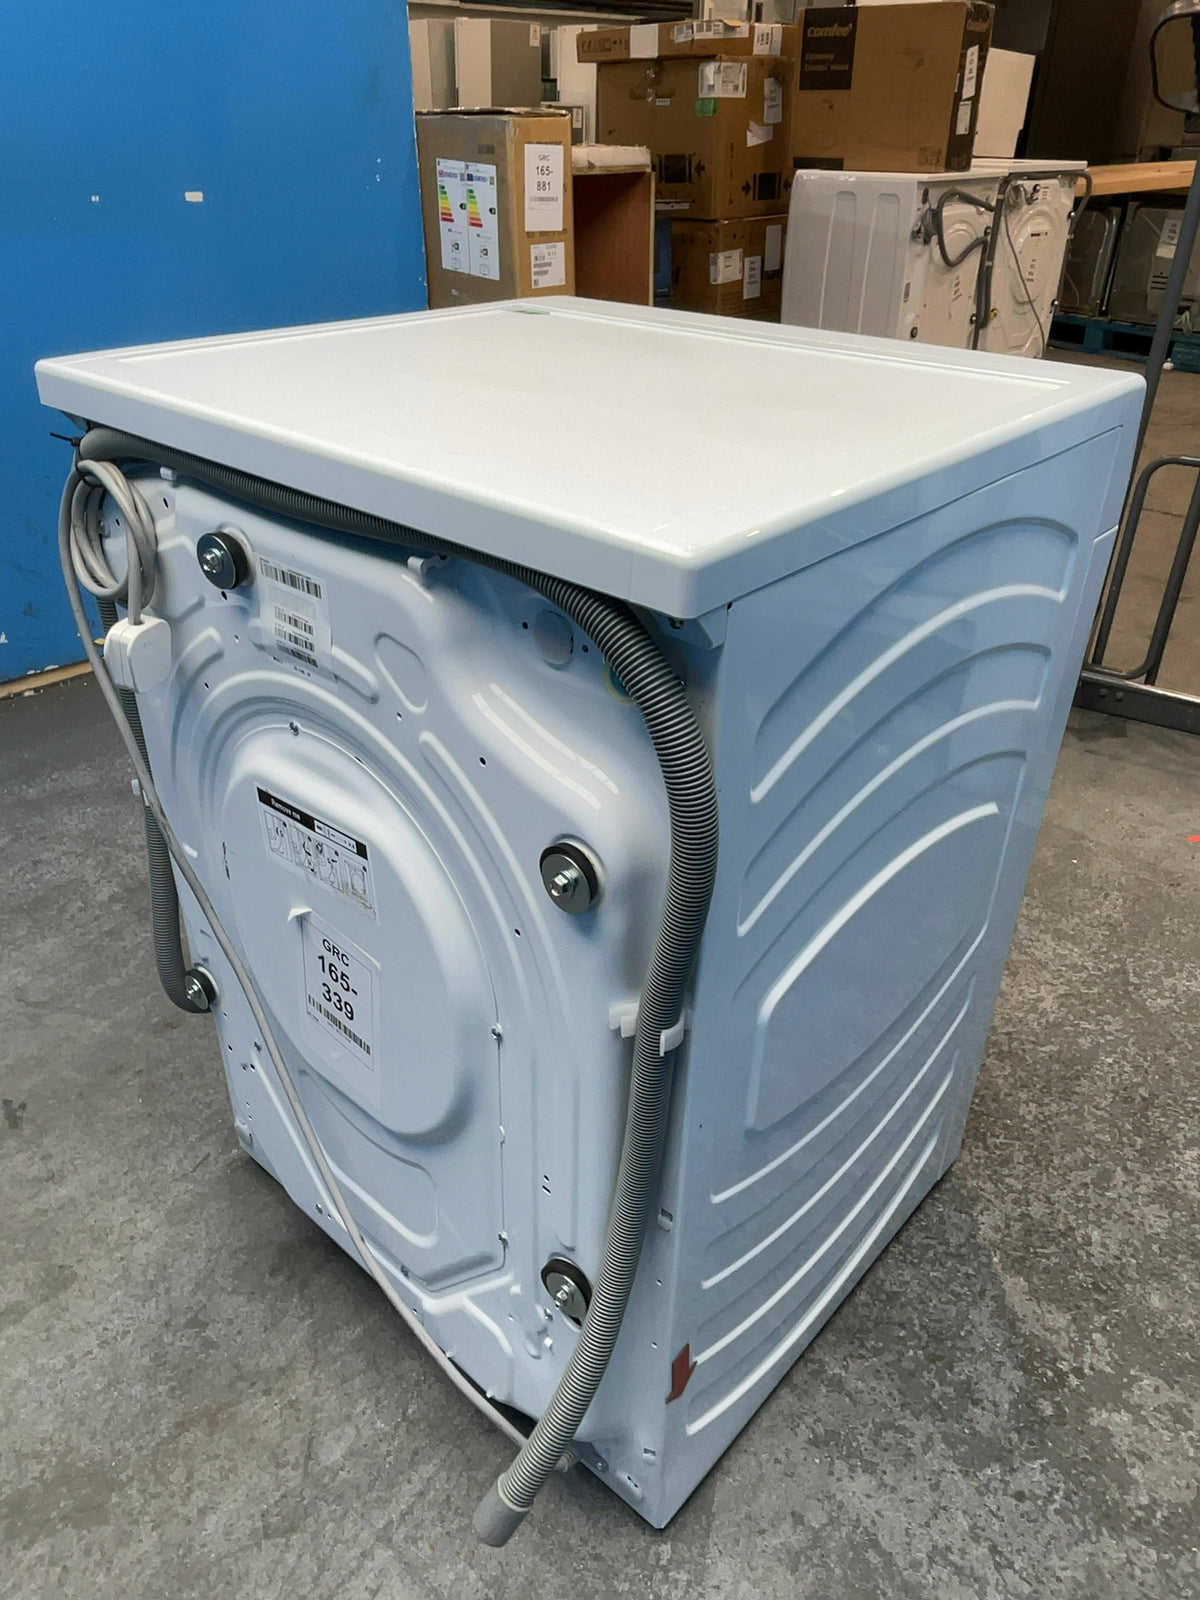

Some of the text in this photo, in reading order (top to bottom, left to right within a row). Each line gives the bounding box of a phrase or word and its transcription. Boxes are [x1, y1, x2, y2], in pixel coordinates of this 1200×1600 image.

[535, 165, 554, 176] 165-
[536, 181, 551, 191] 881
[322, 938, 350, 967] GRC
[317, 955, 358, 996] 165-
[321, 982, 354, 1021] 339
